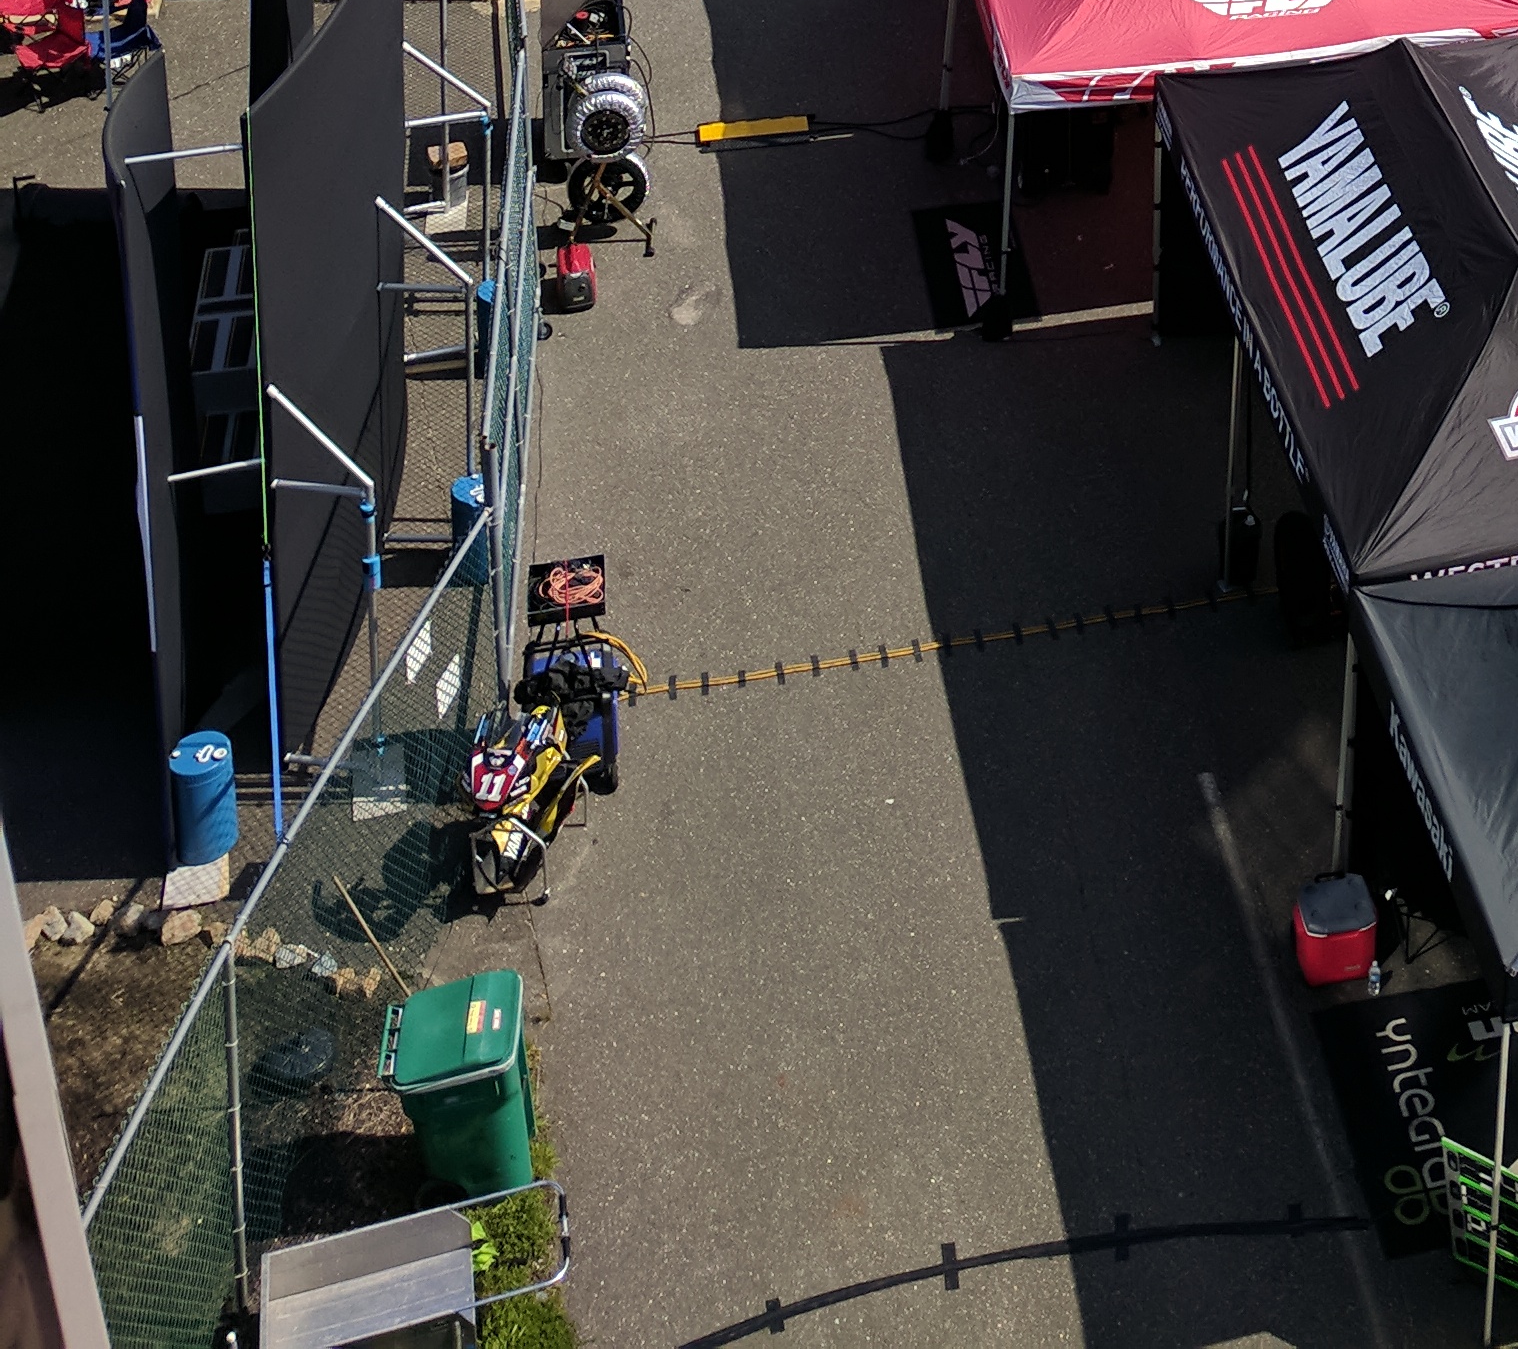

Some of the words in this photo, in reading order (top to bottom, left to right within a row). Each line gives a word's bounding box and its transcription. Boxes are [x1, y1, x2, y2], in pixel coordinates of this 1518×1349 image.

[1229, 8, 1321, 21] RACING
[1278, 100, 1446, 358] YAMALUBE
[1262, 366, 1305, 484] BOTTLE
[475, 772, 507, 802] 11
[1389, 700, 1453, 883] Kawasaki
